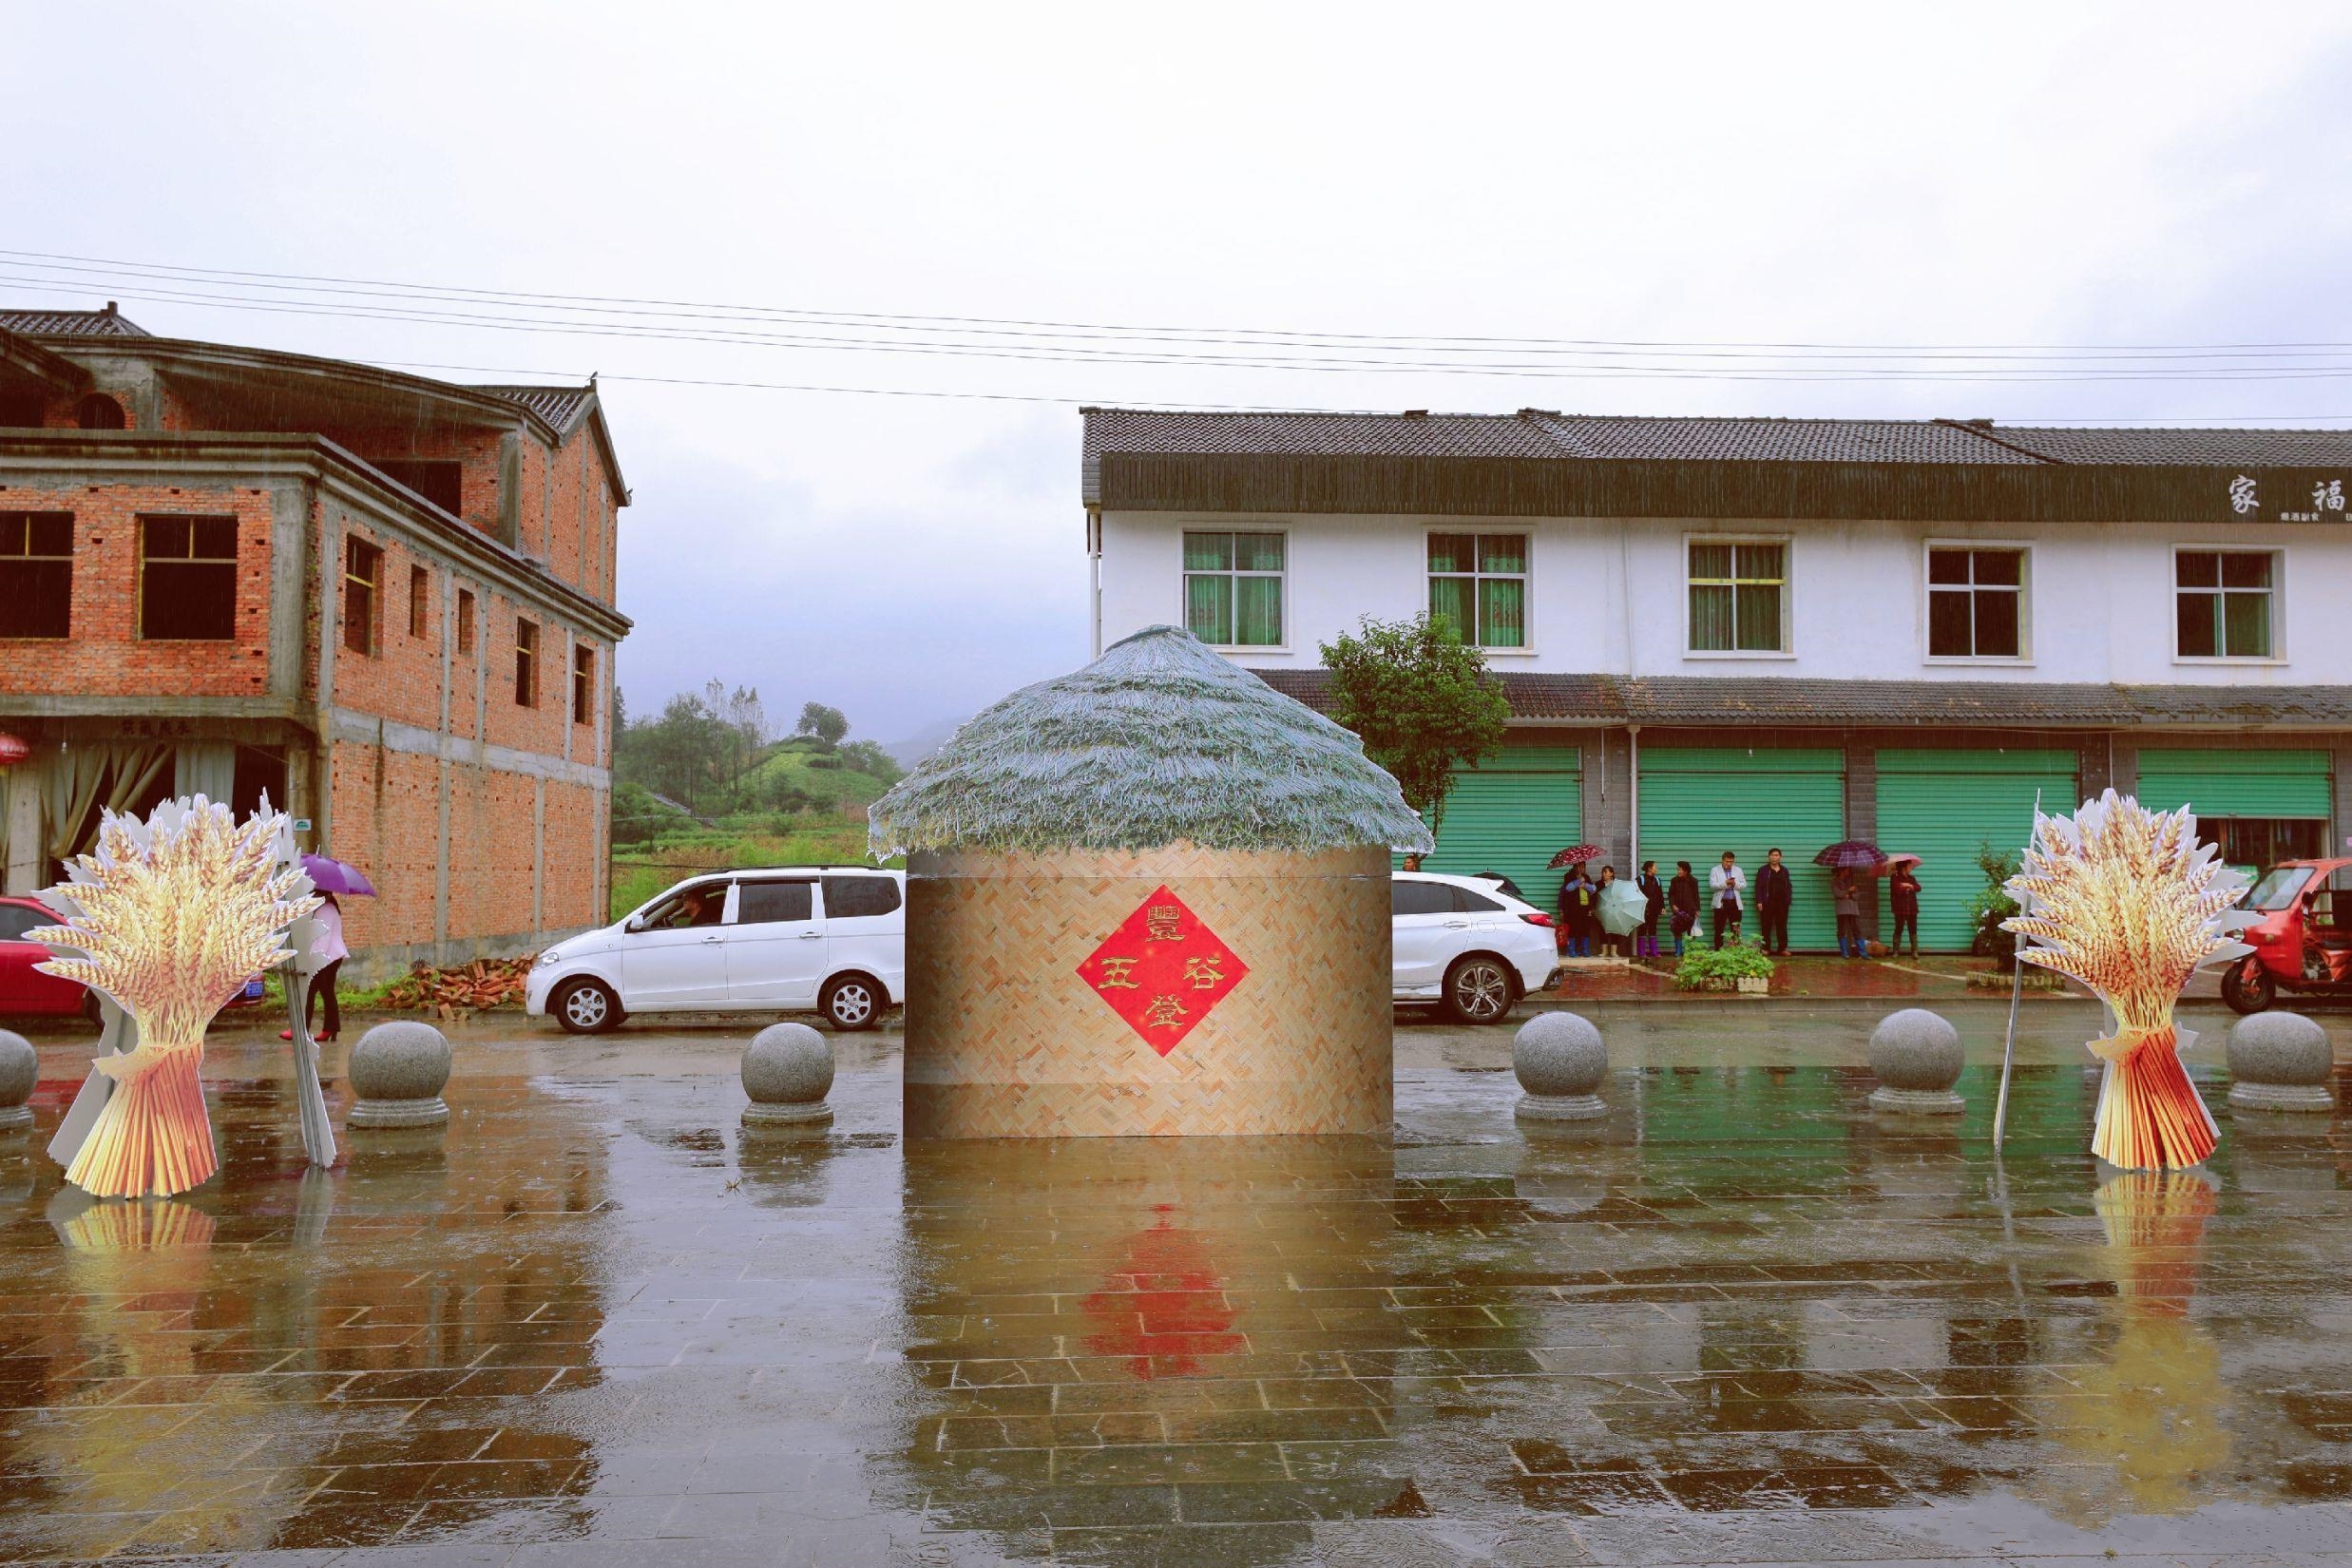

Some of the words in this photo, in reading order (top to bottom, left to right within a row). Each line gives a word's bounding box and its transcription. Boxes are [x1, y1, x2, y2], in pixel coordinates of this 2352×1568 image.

[1098, 956, 1141, 989] 五
[1183, 956, 1226, 990] 谷
[1145, 993, 1189, 1028] 登
